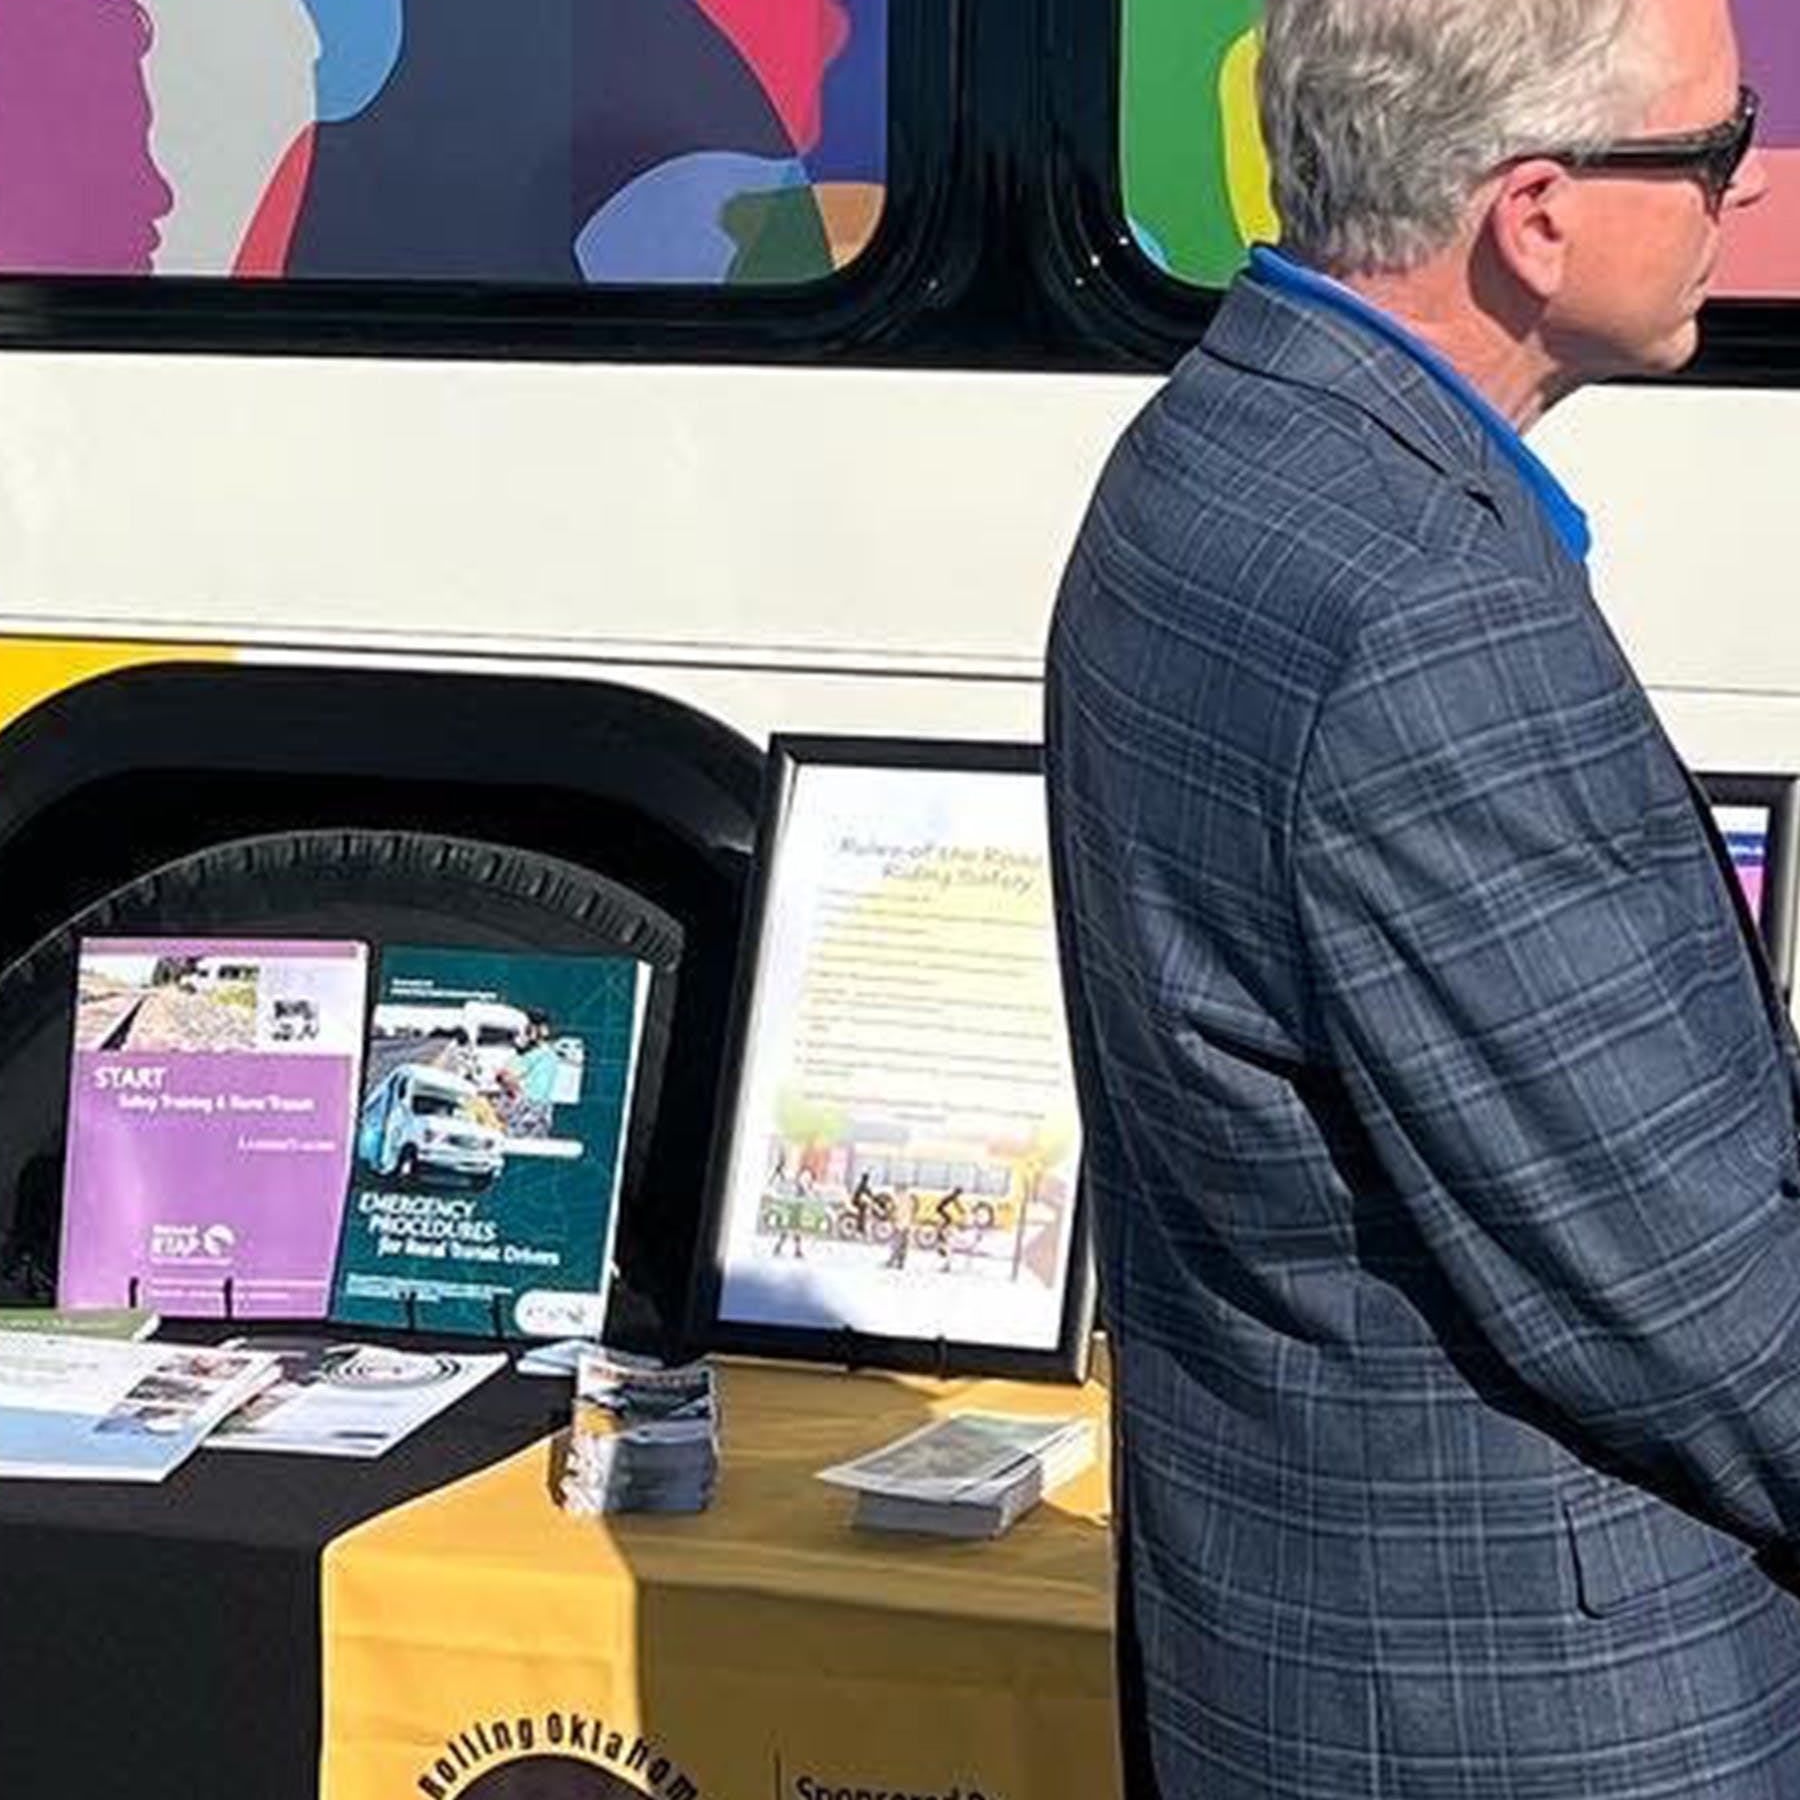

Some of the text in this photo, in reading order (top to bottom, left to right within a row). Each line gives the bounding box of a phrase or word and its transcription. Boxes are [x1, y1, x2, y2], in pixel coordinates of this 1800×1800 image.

[93, 1065, 168, 1090] START
[357, 1191, 479, 1220] EMERGENCY
[368, 1212, 500, 1243] PROCEDURES
[417, 1717, 534, 1800] Rolling
